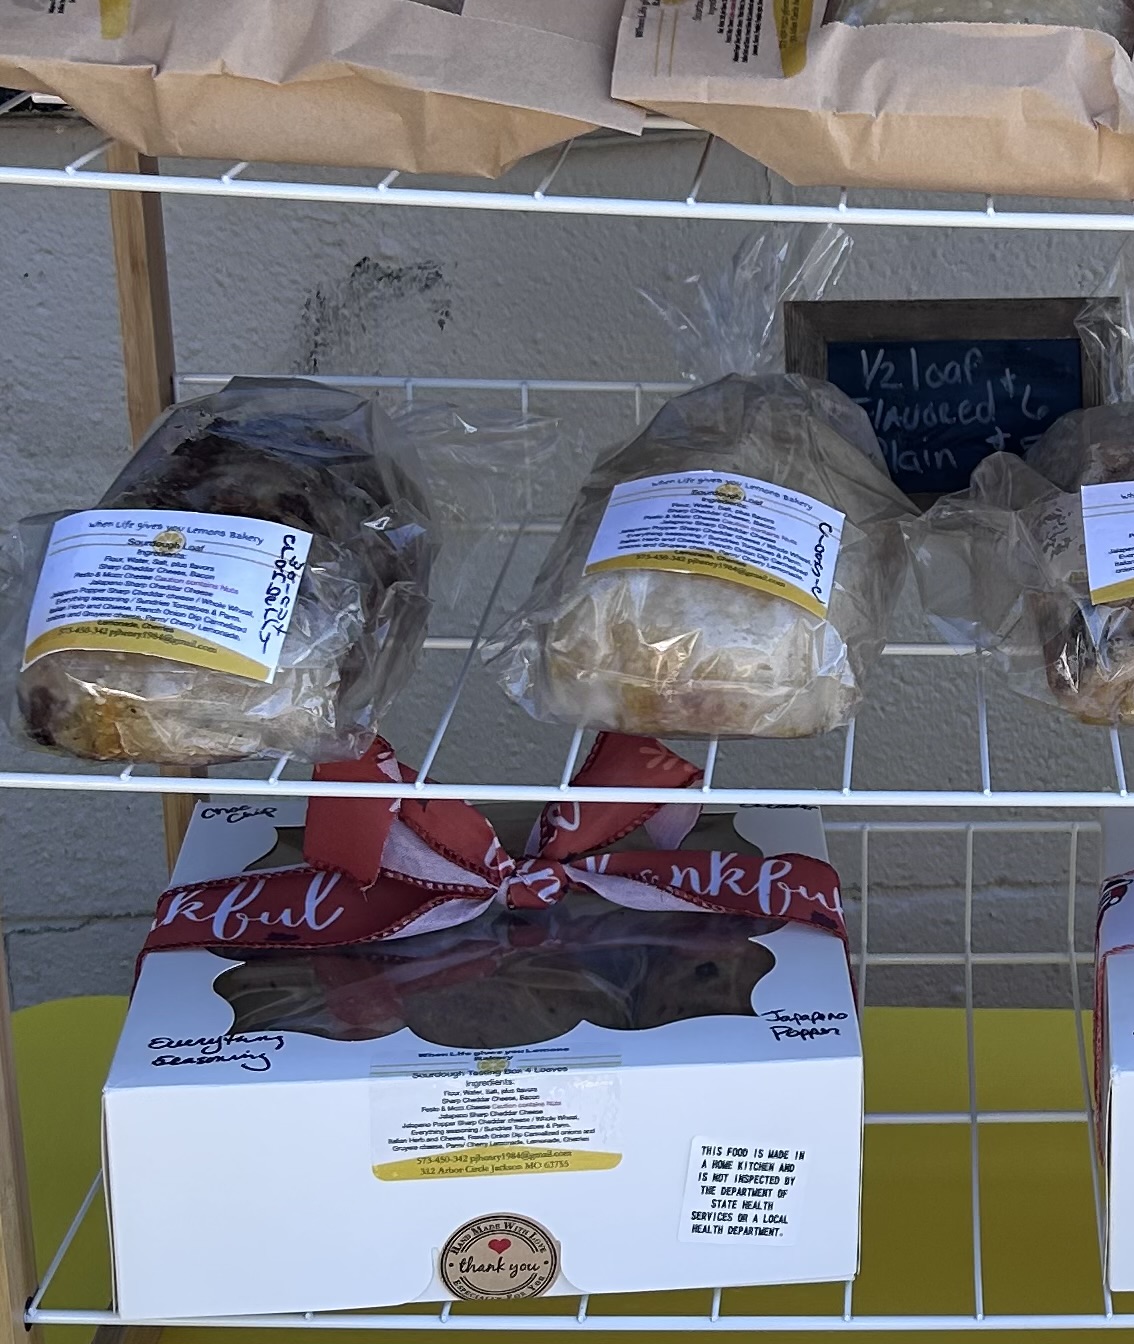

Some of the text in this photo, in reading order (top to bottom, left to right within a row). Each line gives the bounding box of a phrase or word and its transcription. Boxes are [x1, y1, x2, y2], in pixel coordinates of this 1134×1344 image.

[137, 522, 163, 532] gives
[187, 526, 226, 537] Lemons
[230, 531, 265, 546] Bakery
[701, 1145, 806, 1161] THIS FOOD IS MADE IN
[712, 1159, 733, 1170] HOME
[737, 1161, 775, 1172] KITCHEN
[779, 1163, 796, 1173] AND
[698, 1172, 796, 1186] IS NOT INSPECTED BY
[700, 1185, 788, 1199] THE DEPARTMENT OF
[711, 1199, 774, 1211] STATE HEALTH
[691, 1210, 733, 1222] SERVICES
[737, 1213, 749, 1223] OR
[763, 1214, 788, 1224] LOCAL
[691, 1224, 724, 1235] HEALTH
[458, 1255, 541, 1279] thank you
